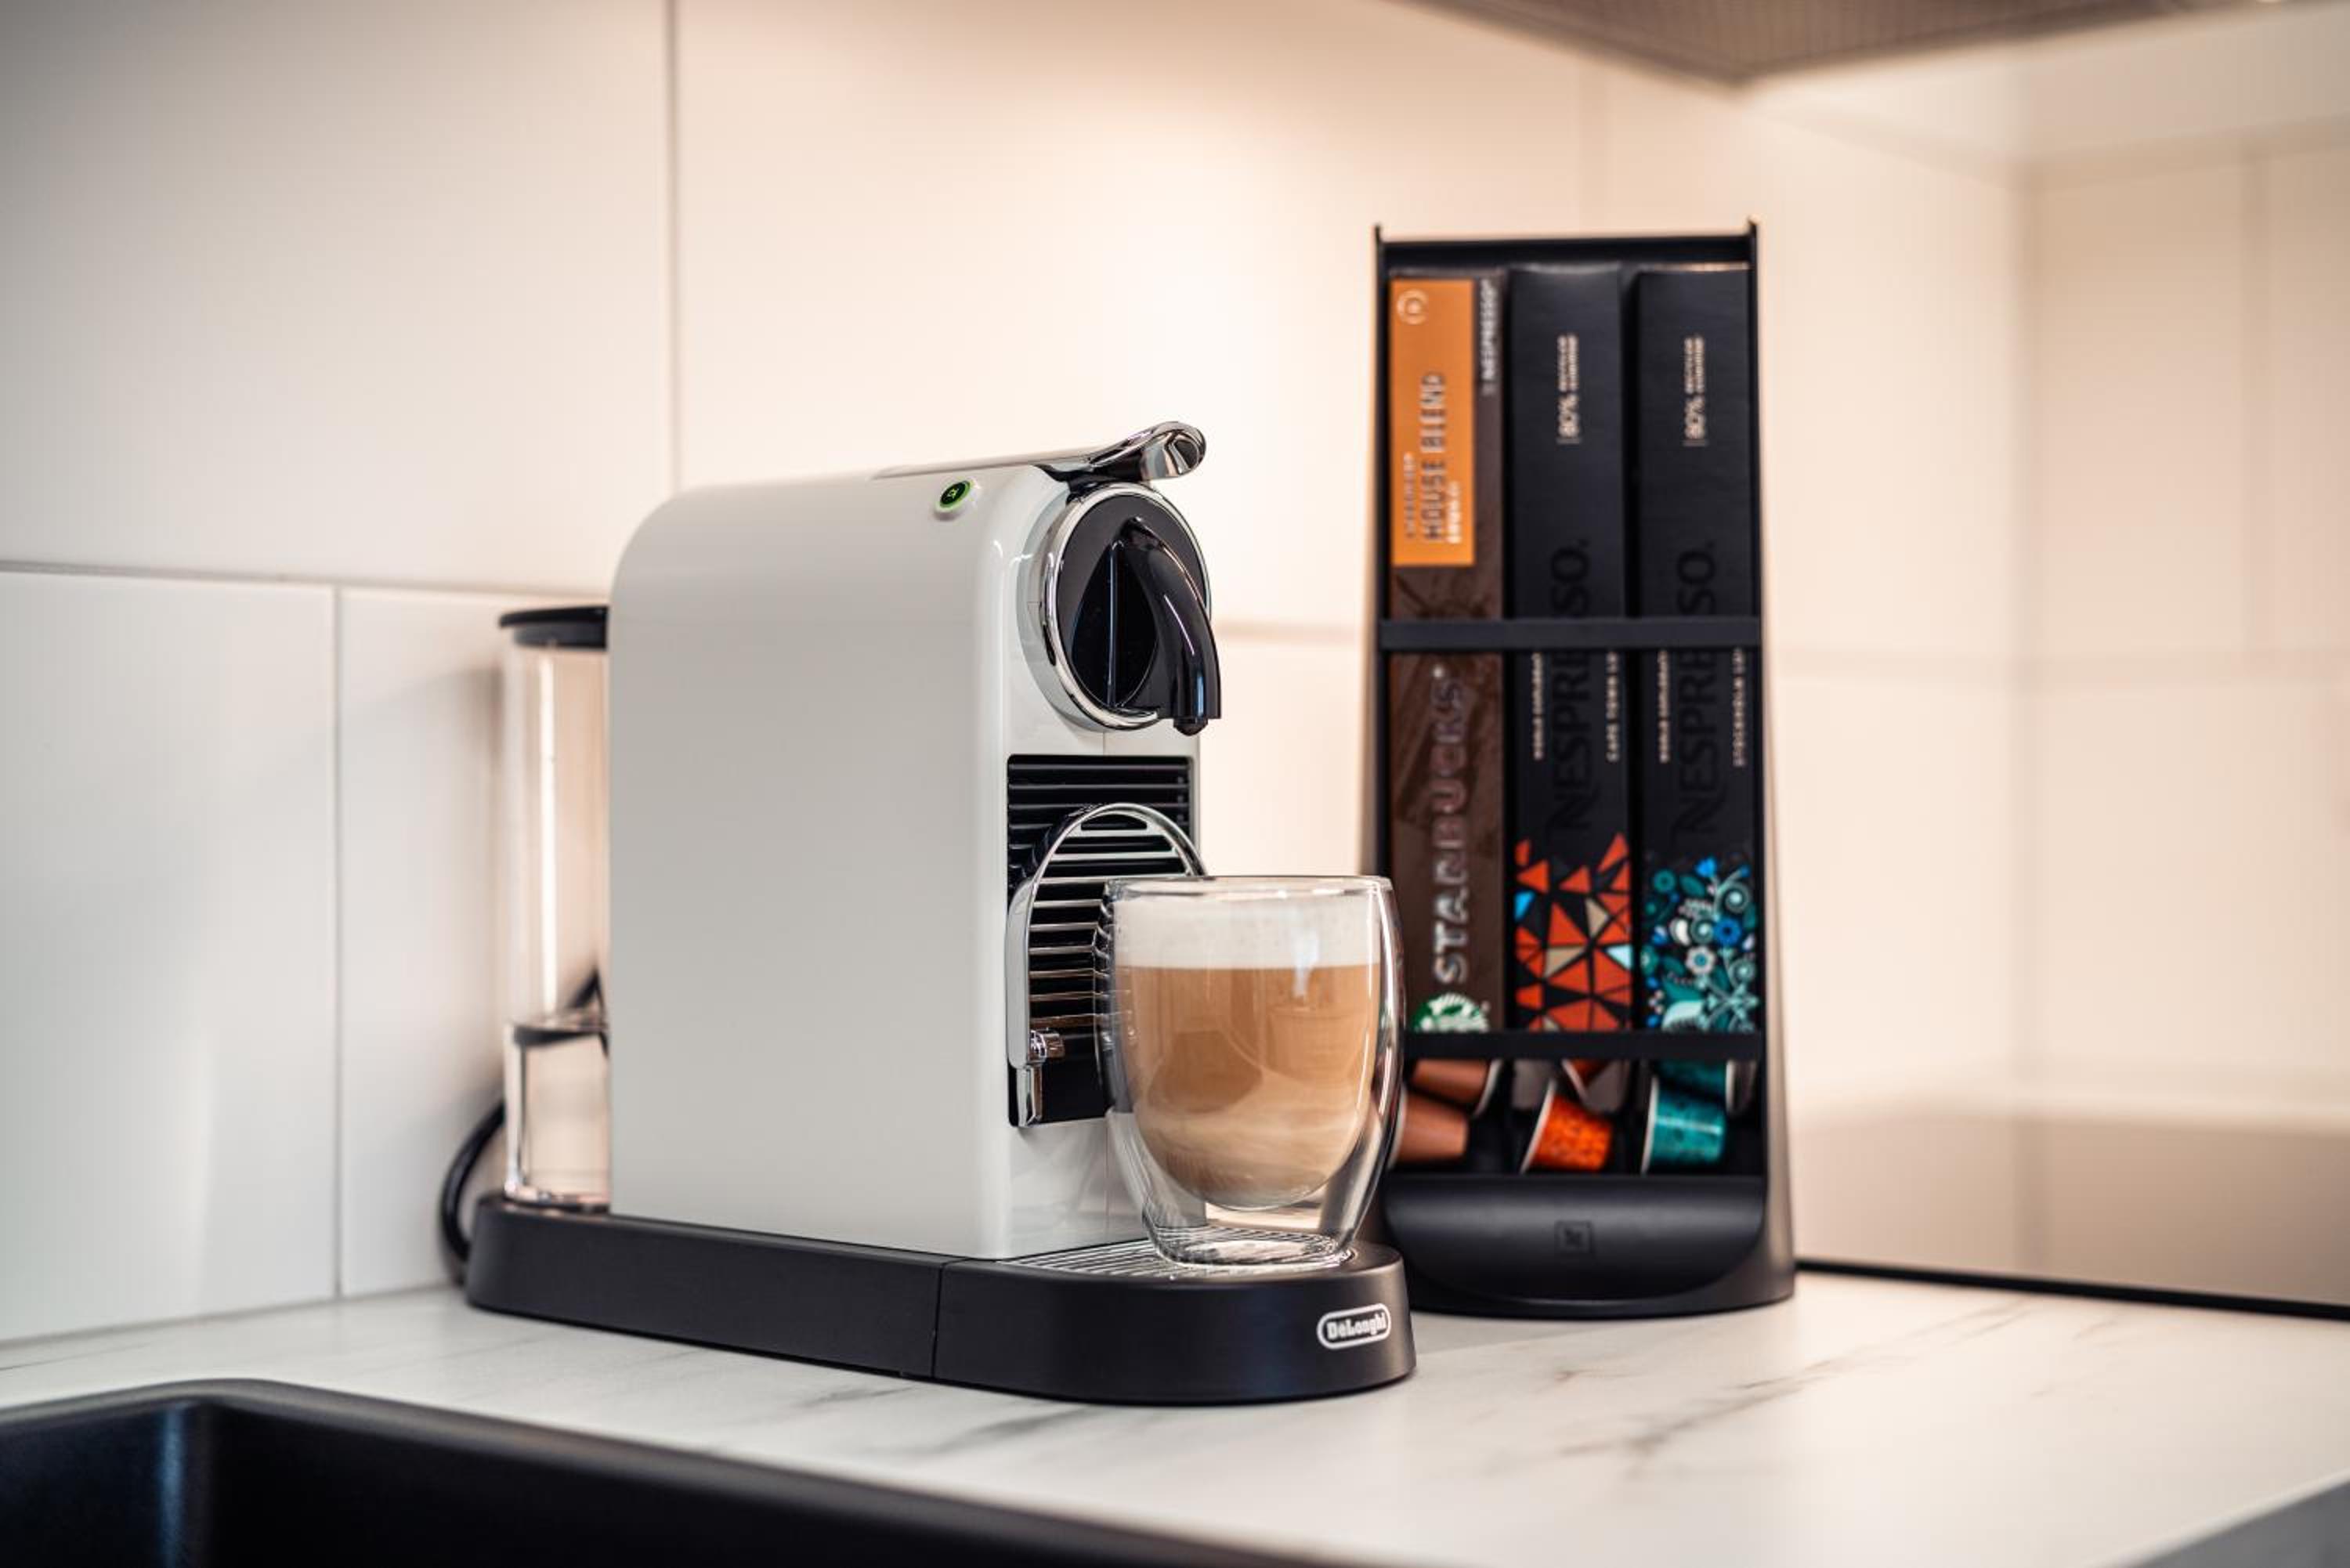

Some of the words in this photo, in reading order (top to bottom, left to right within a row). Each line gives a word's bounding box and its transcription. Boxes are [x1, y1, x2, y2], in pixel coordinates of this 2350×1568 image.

[1419, 373, 1446, 453] BLEND
[1419, 460, 1446, 542] HOUSE
[1431, 678, 1469, 985] STARBUCKS
